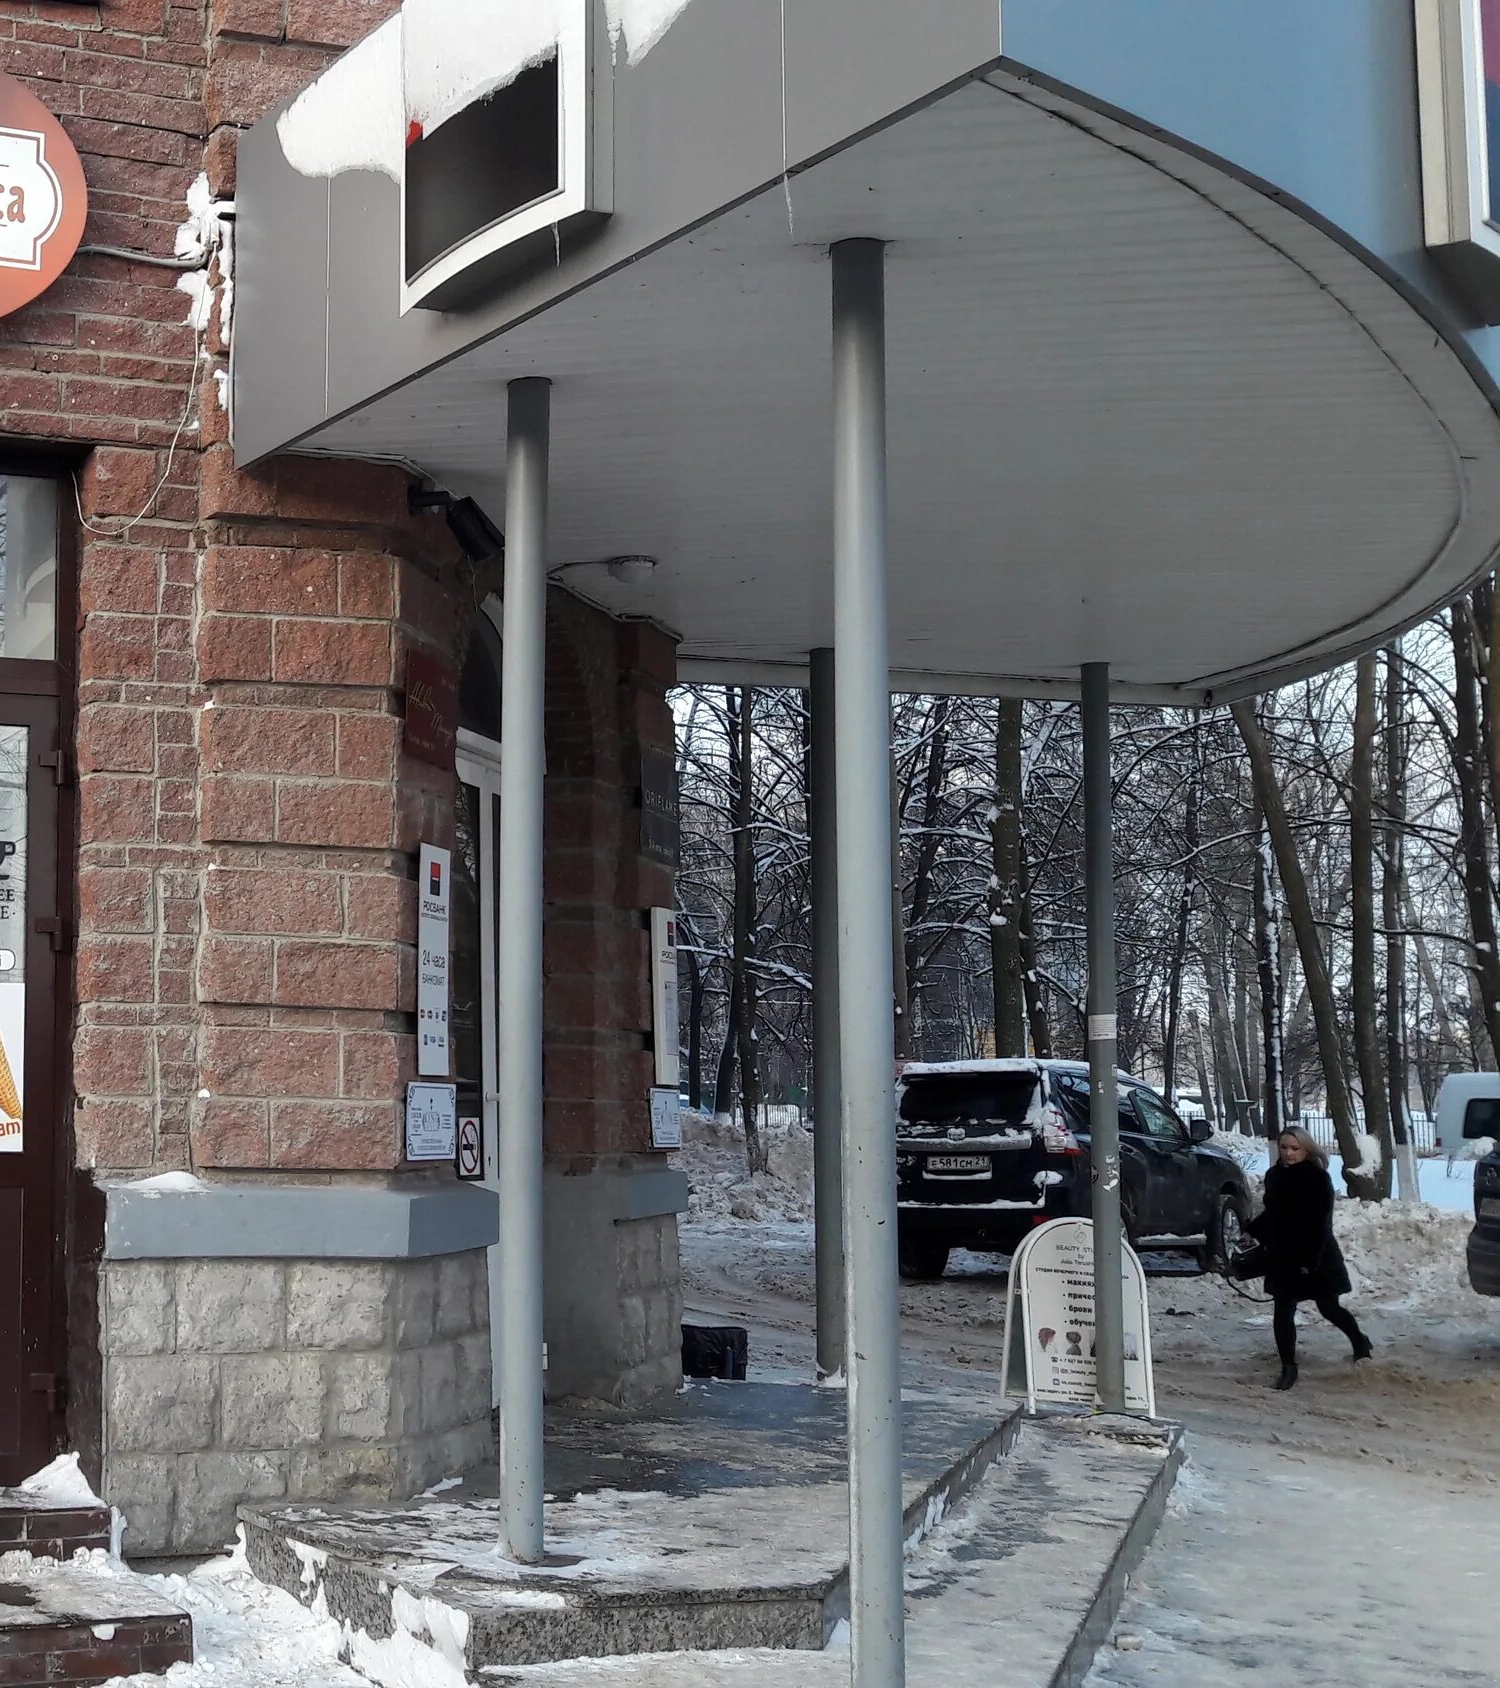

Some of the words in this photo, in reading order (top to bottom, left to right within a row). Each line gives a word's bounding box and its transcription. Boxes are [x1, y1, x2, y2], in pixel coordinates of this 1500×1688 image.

[422, 900, 446, 916] РОСБАНК
[422, 950, 431, 966] 24
[432, 954, 446, 969] часа
[1056, 1244, 1080, 1252] BEAUTY
[1068, 1304, 1093, 1314] брови
